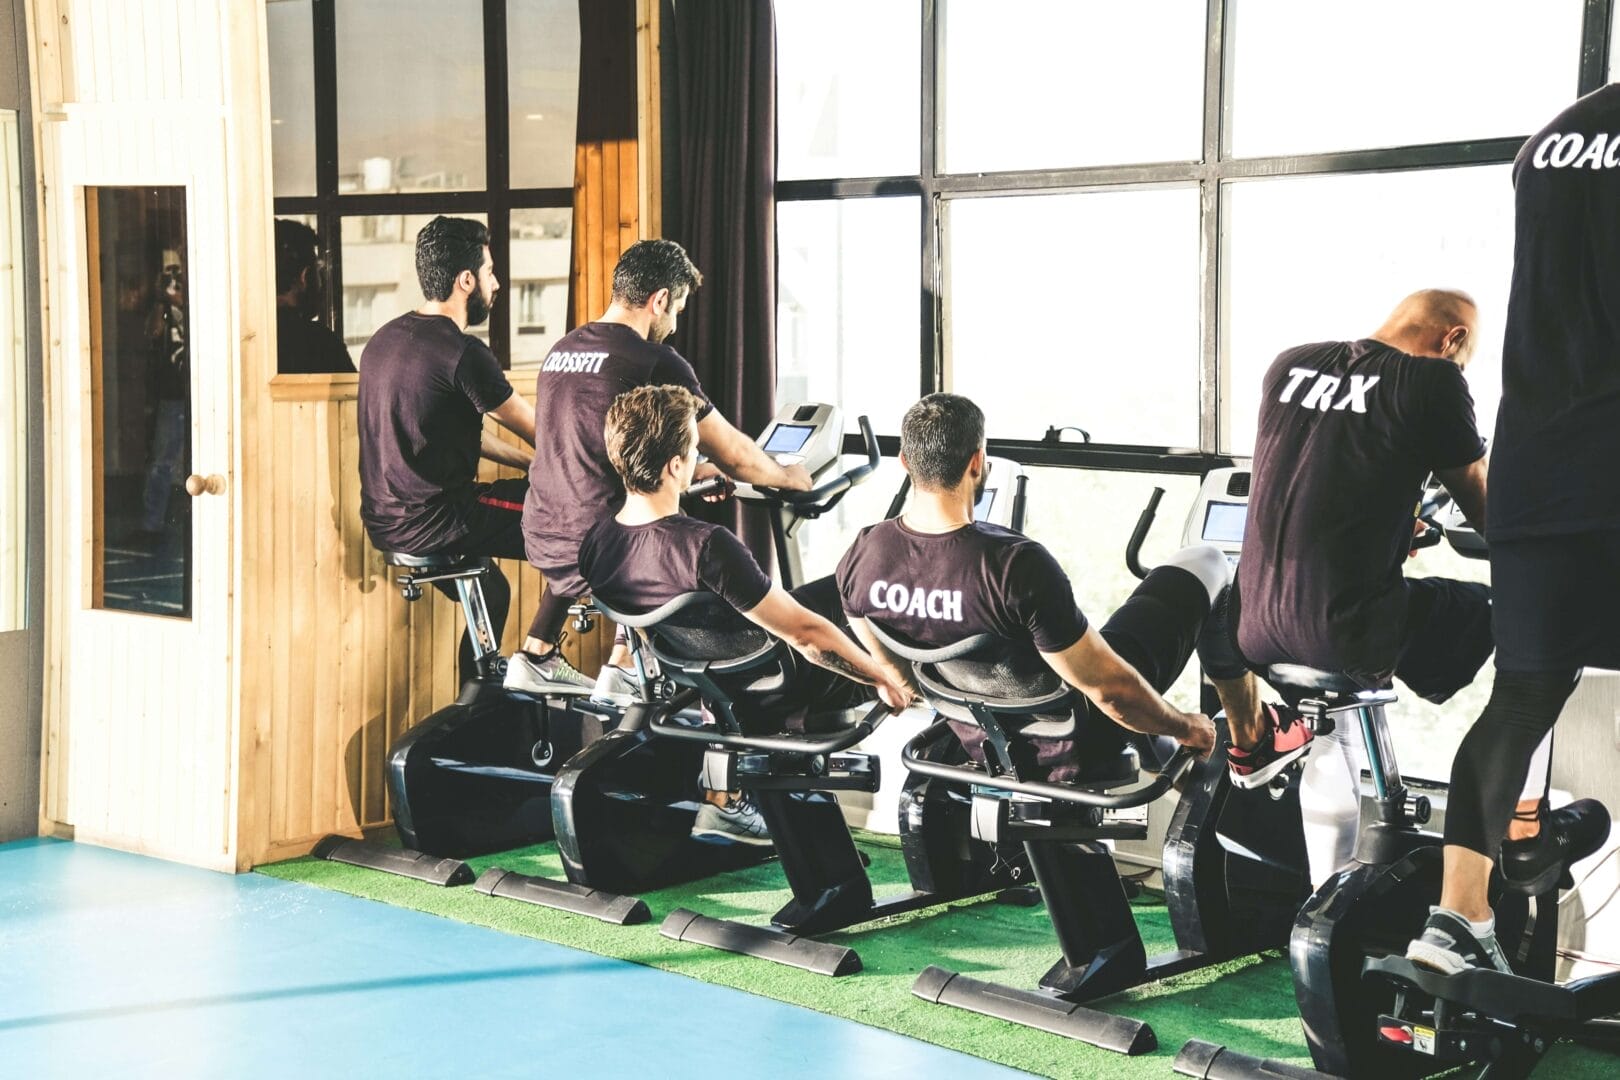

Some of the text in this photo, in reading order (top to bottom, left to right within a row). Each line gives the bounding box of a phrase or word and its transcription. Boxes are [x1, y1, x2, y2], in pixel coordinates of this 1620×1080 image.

[1532, 132, 1620, 170] COAC
[542, 351, 610, 374] CROSSFIT
[1279, 367, 1381, 414] TRX
[869, 580, 964, 622] COACH
